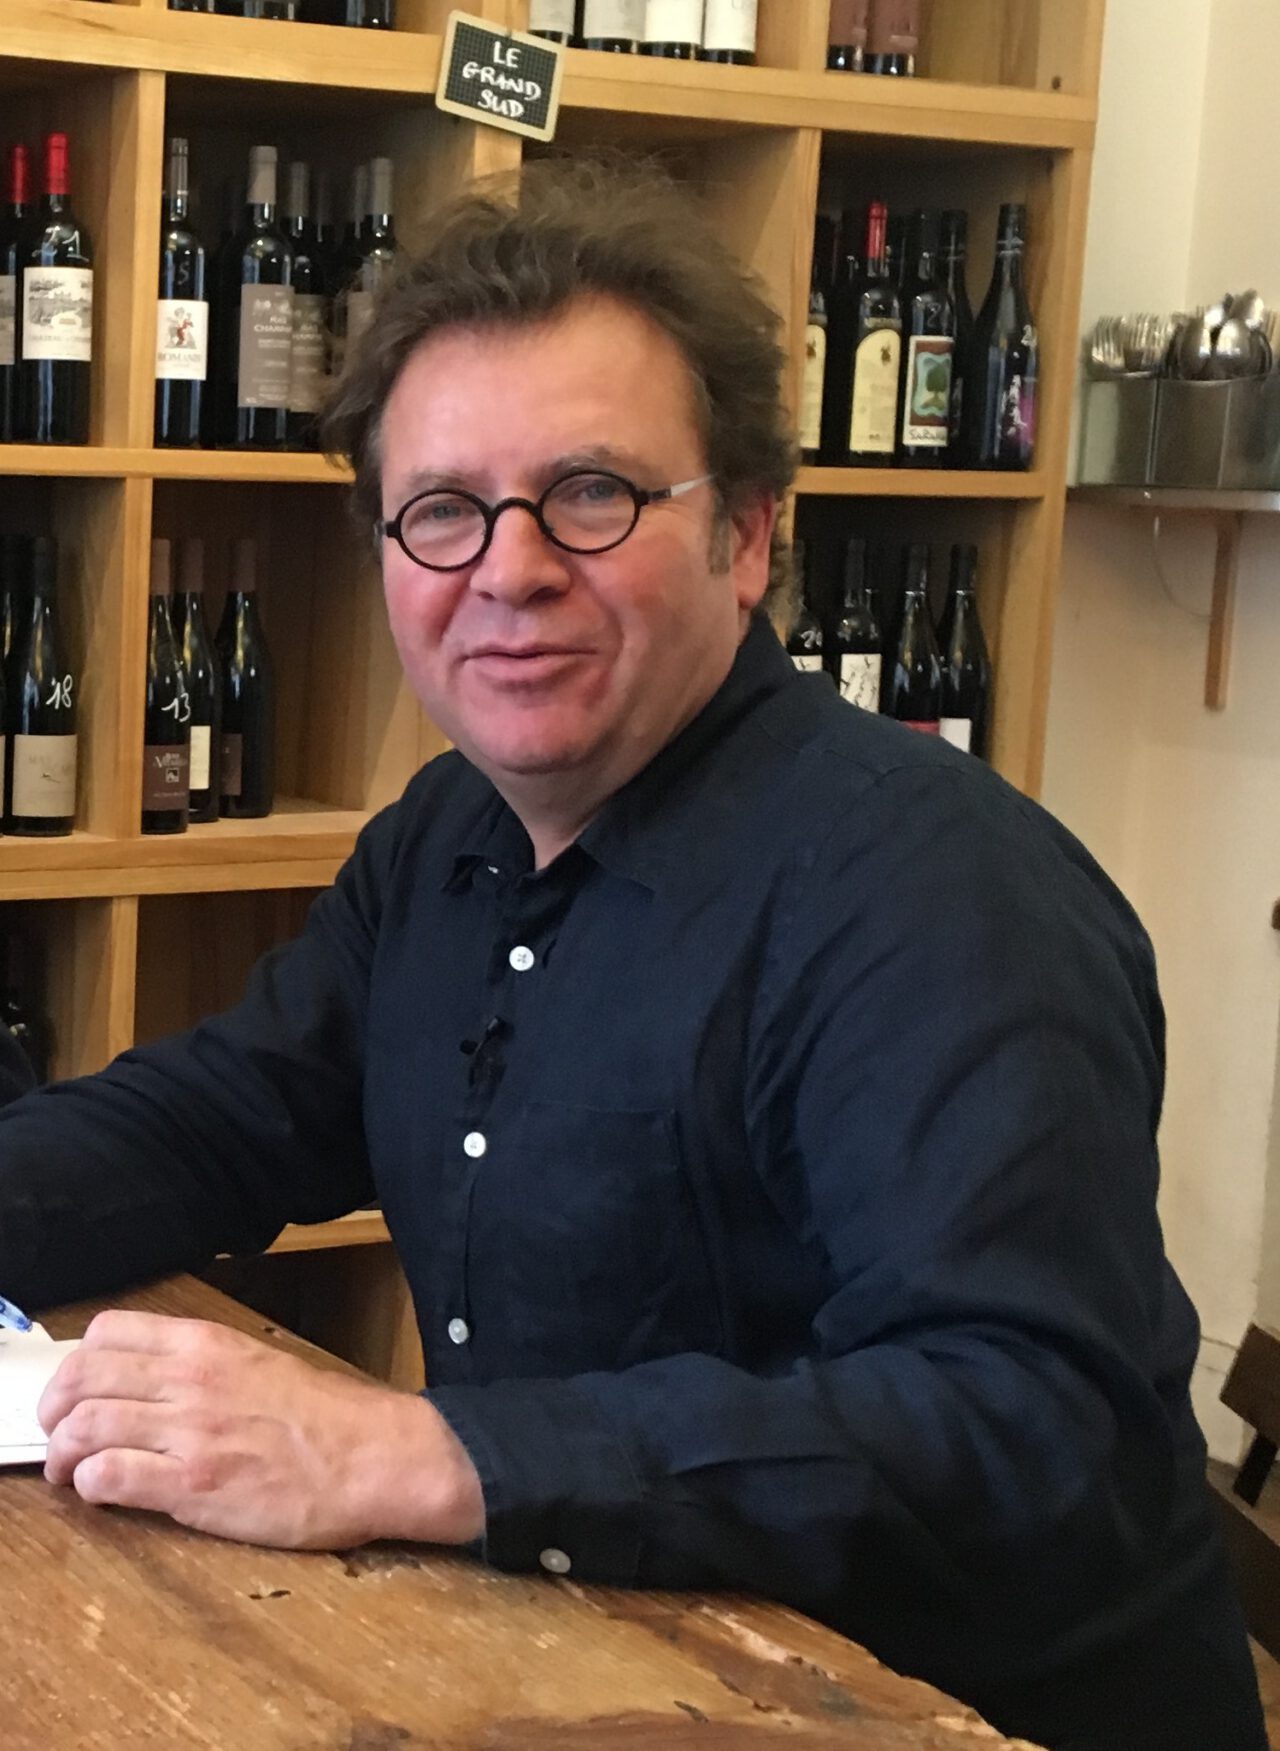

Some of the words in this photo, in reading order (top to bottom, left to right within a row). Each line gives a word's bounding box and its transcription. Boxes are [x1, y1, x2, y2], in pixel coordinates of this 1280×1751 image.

[492, 40, 521, 68] LE
[461, 61, 542, 101] GRAND
[477, 88, 524, 118] SUD
[46, 675, 73, 710] 18
[160, 692, 191, 723] 13
